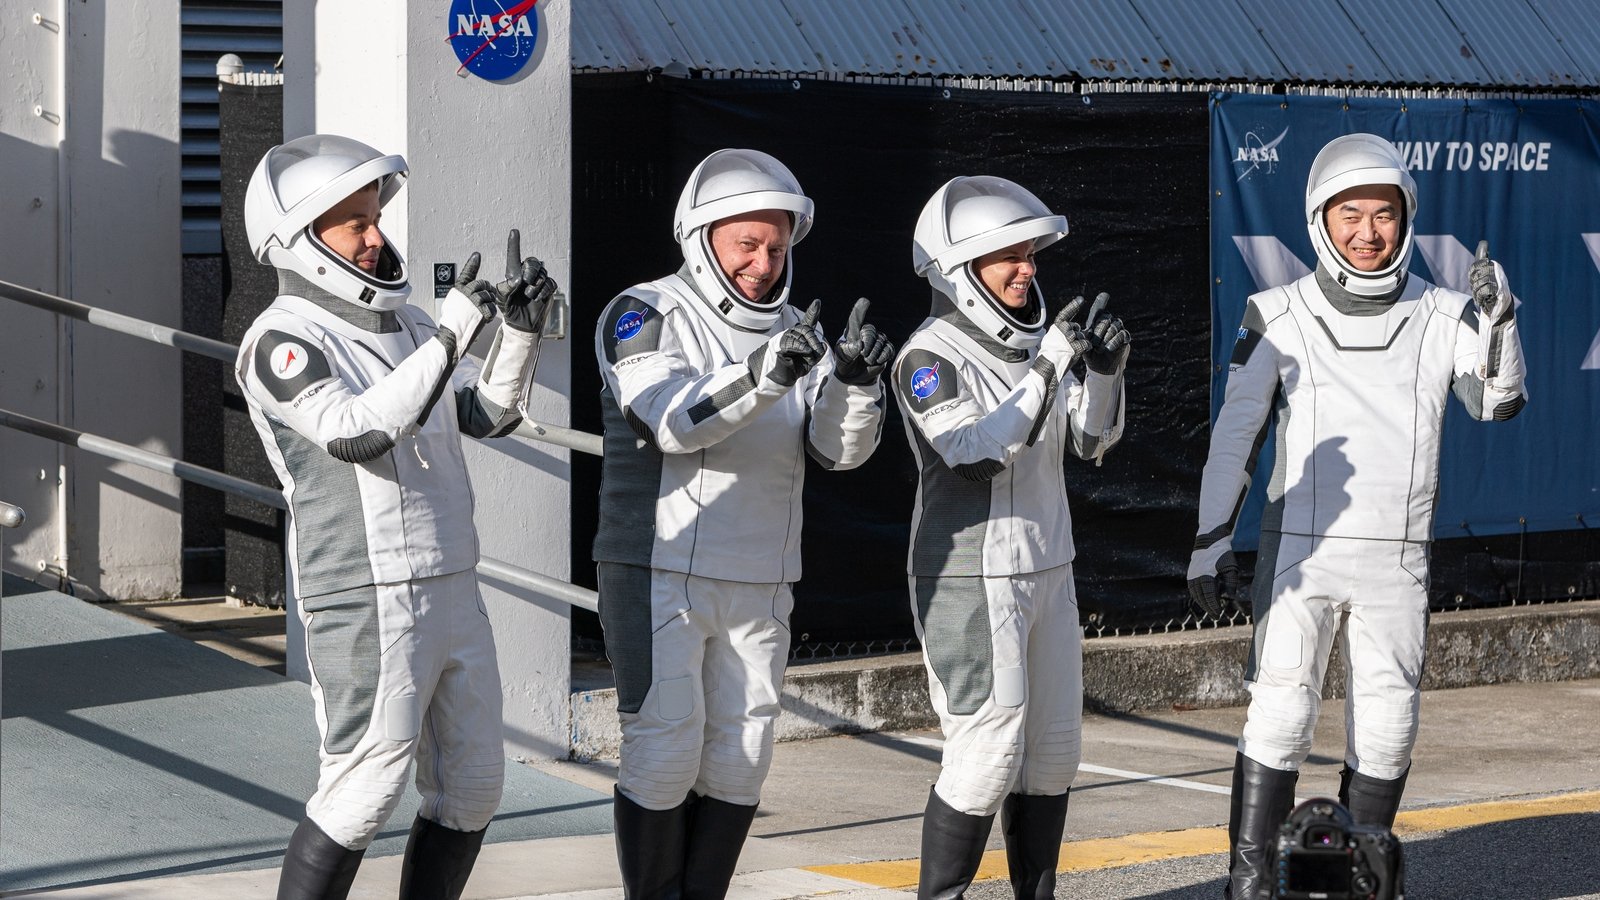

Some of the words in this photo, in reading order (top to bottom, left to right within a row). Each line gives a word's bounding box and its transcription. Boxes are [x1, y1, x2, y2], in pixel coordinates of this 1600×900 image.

[457, 13, 534, 37] NASA
[1237, 147, 1280, 162] NASA
[1446, 141, 1474, 172] TO
[1478, 141, 1552, 172] SPACE
[618, 320, 641, 332] NASA
[914, 374, 937, 391] NASA
[922, 399, 962, 423] SPACEX
